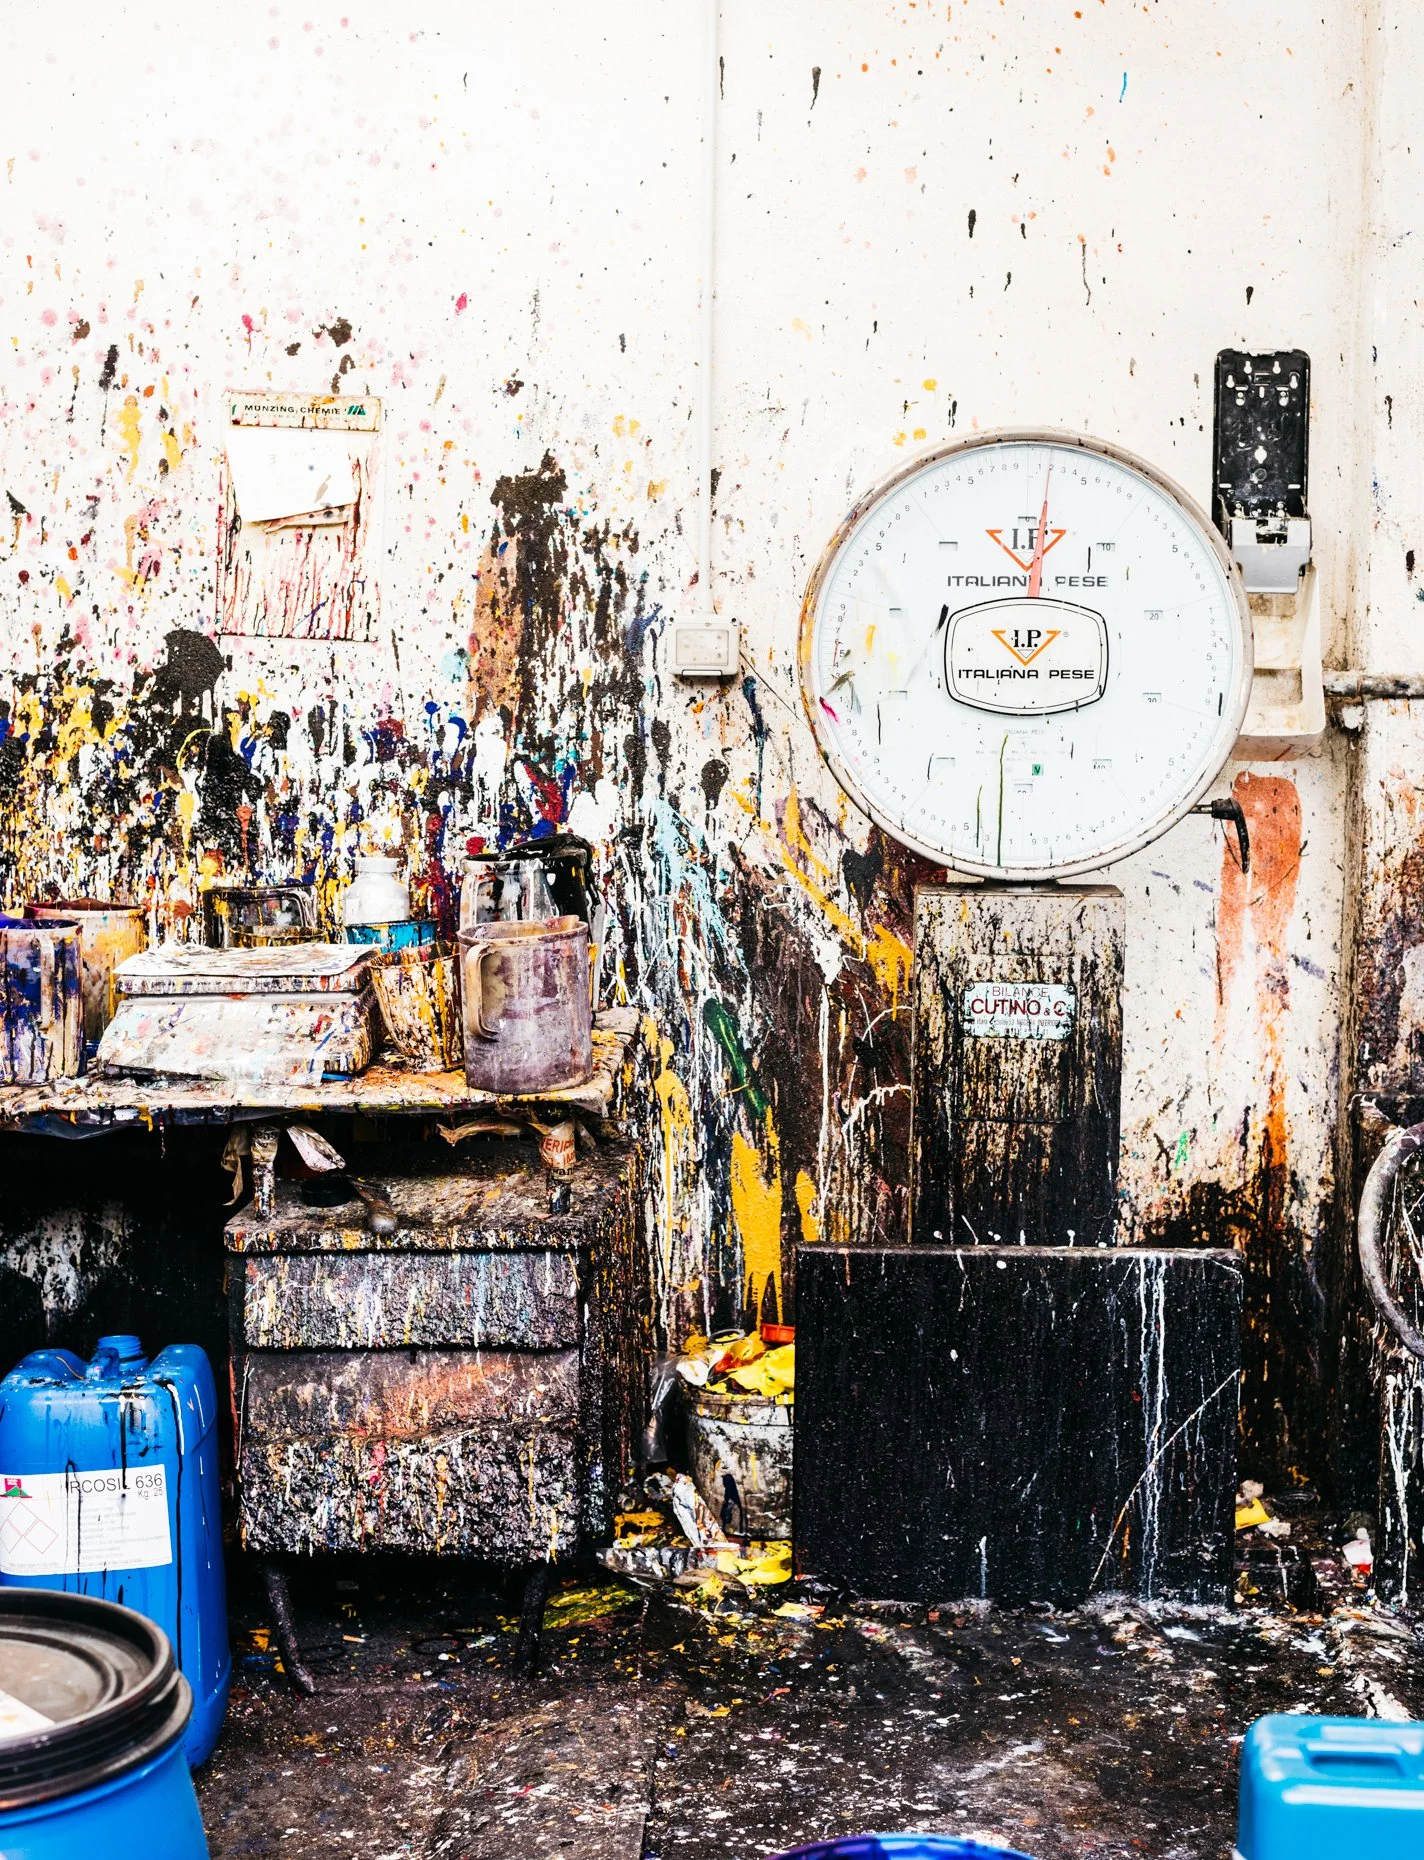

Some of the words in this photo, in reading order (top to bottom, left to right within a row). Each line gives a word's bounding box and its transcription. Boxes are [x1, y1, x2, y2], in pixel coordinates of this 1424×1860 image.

[300, 406, 341, 415] CHEMIE
[967, 476, 975, 485] 5
[1080, 476, 1087, 486] 5
[875, 542, 882, 551] 5
[1171, 544, 1179, 553] 5
[1055, 576, 1108, 587] PESE
[1150, 612, 1159, 620] 20
[1013, 629, 1042, 648] I.P.
[1206, 652, 1213, 661] 5
[958, 669, 1038, 679] ITALIANA
[1049, 669, 1095, 679] PESE
[1168, 757, 1175, 766] 5
[1034, 765, 1041, 774] V
[963, 822, 970, 831] 5
[992, 986, 1049, 998] BILANCE
[971, 998, 1041, 1016] CUTINO
[1044, 1008, 1050, 1016] &
[136, 1473, 163, 1489] 636
[153, 1486, 164, 1496] 25
